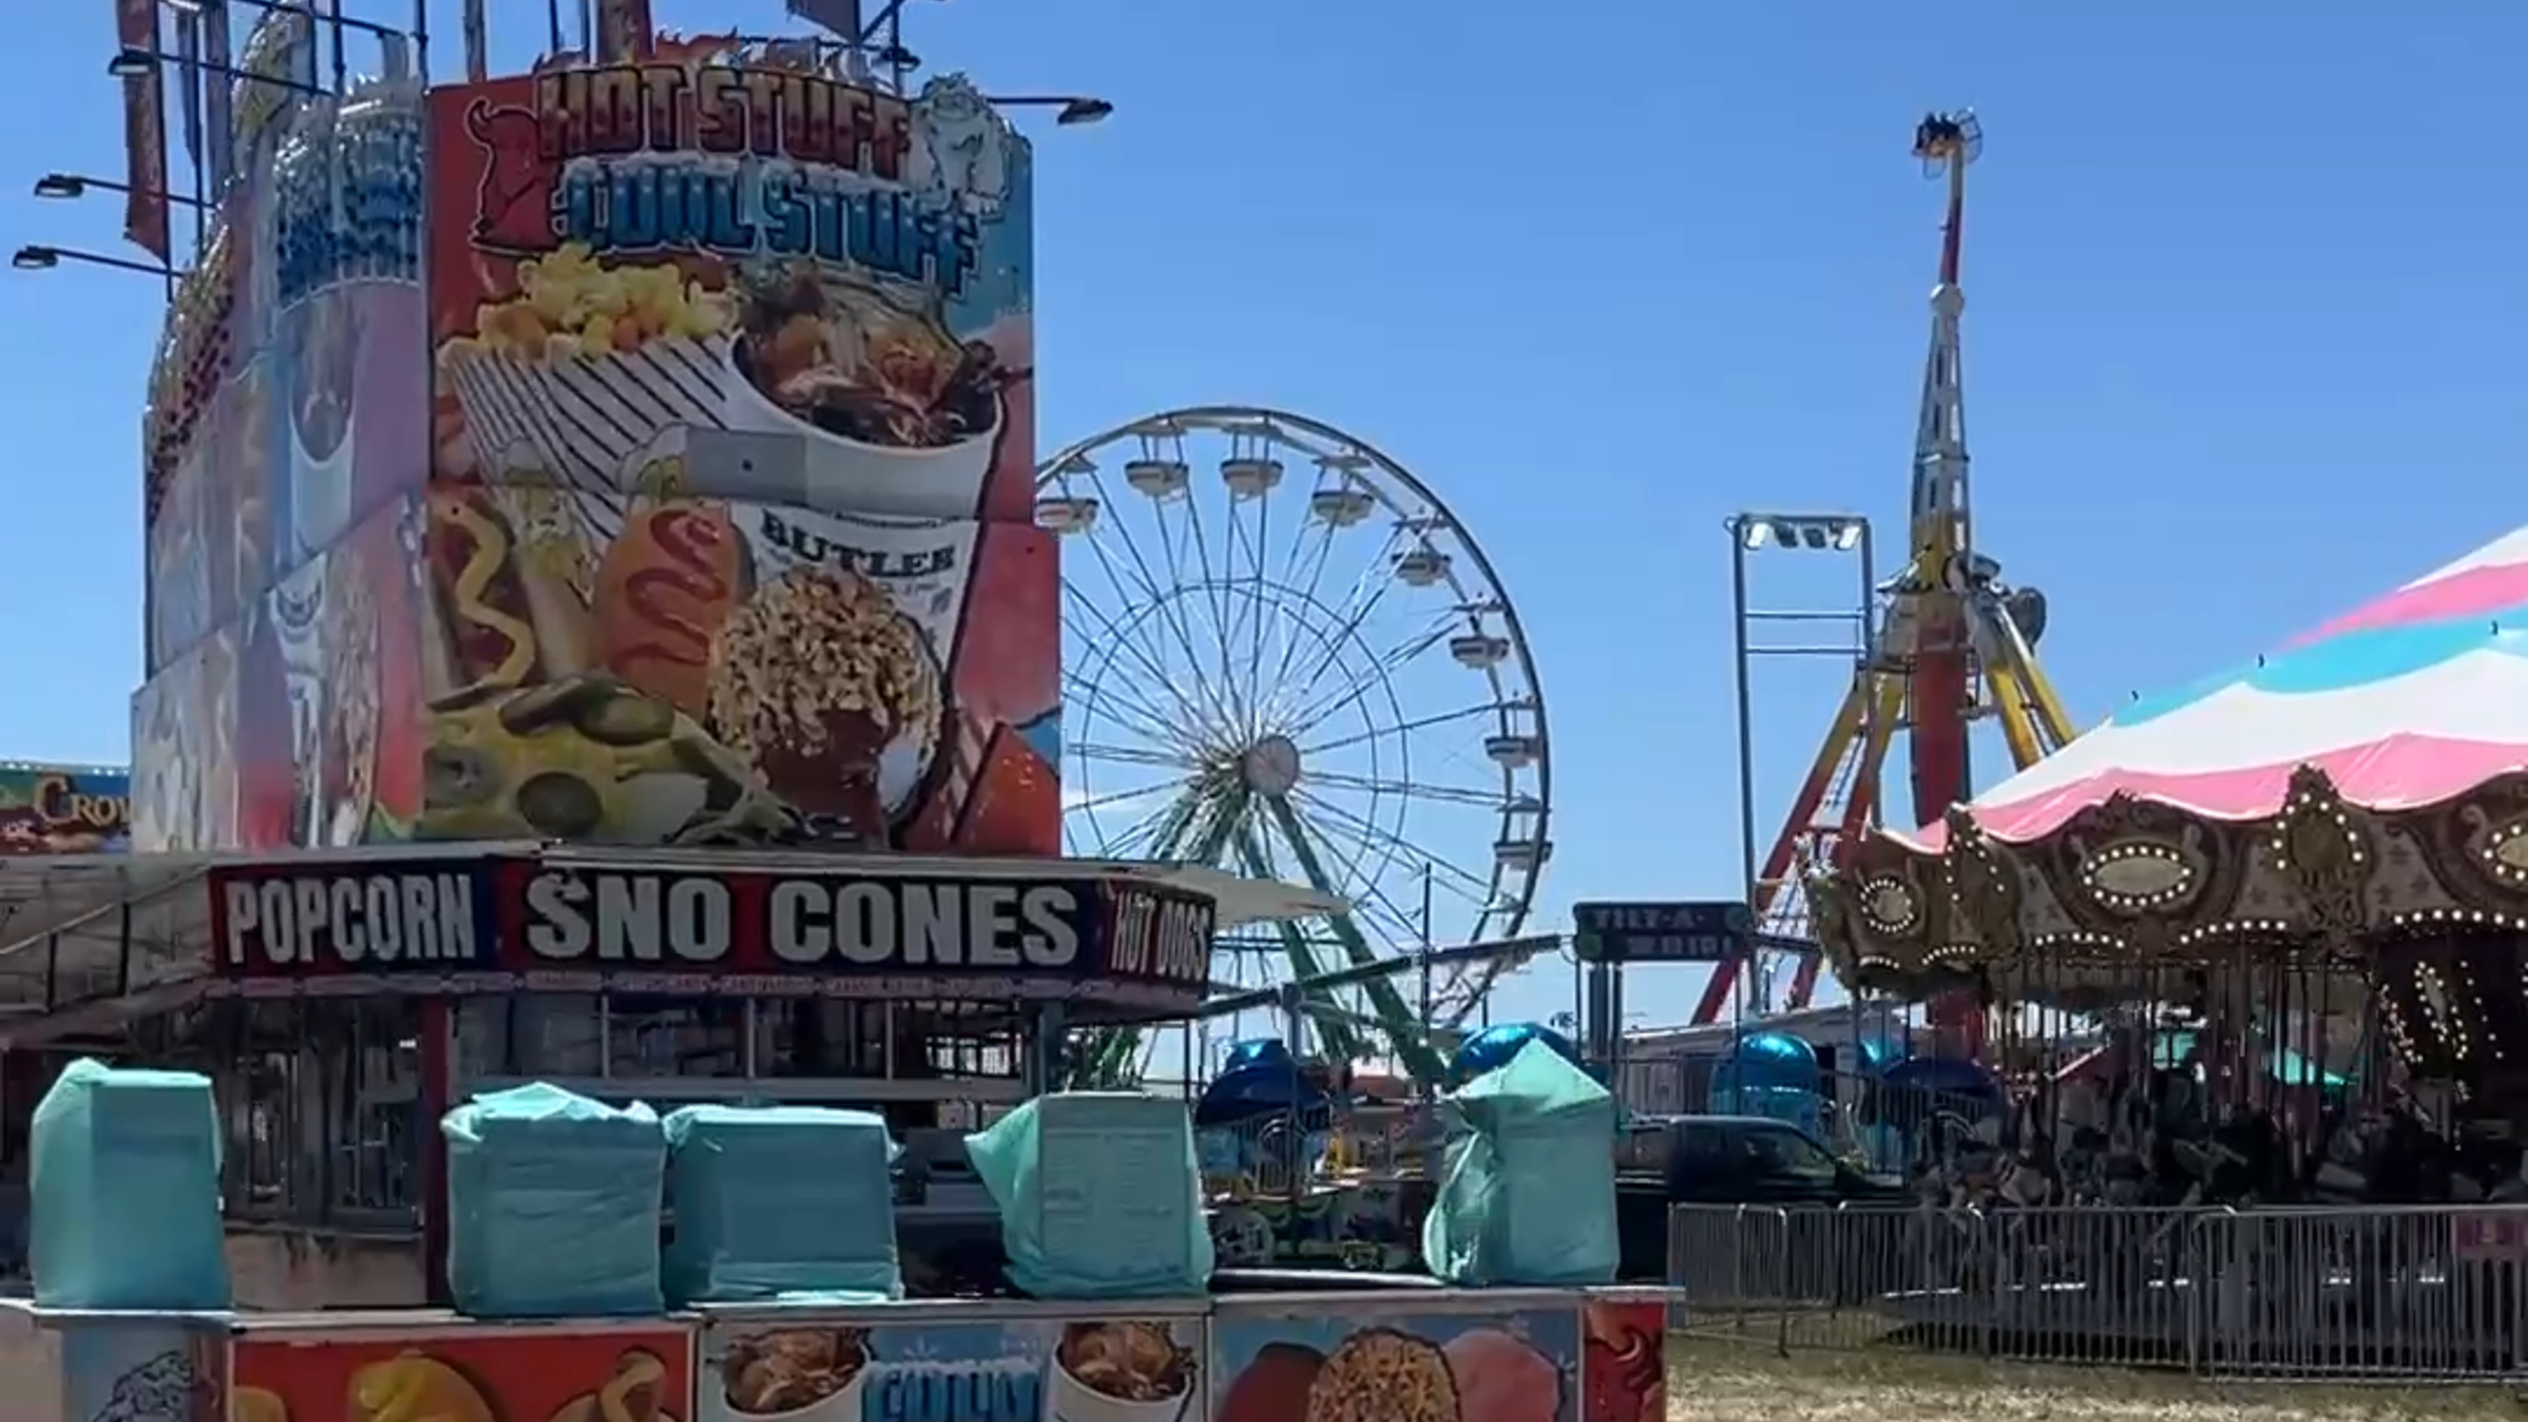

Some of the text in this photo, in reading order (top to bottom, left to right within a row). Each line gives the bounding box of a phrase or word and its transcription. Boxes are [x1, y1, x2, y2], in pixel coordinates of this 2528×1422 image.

[537, 65, 911, 181] HOT STUFF
[553, 157, 756, 256] COOL
[760, 164, 983, 298] STUFF
[226, 873, 475, 963] POPCORN
[526, 869, 1079, 966] SNO CONES
[1111, 889, 1208, 982] HOT DOGS
